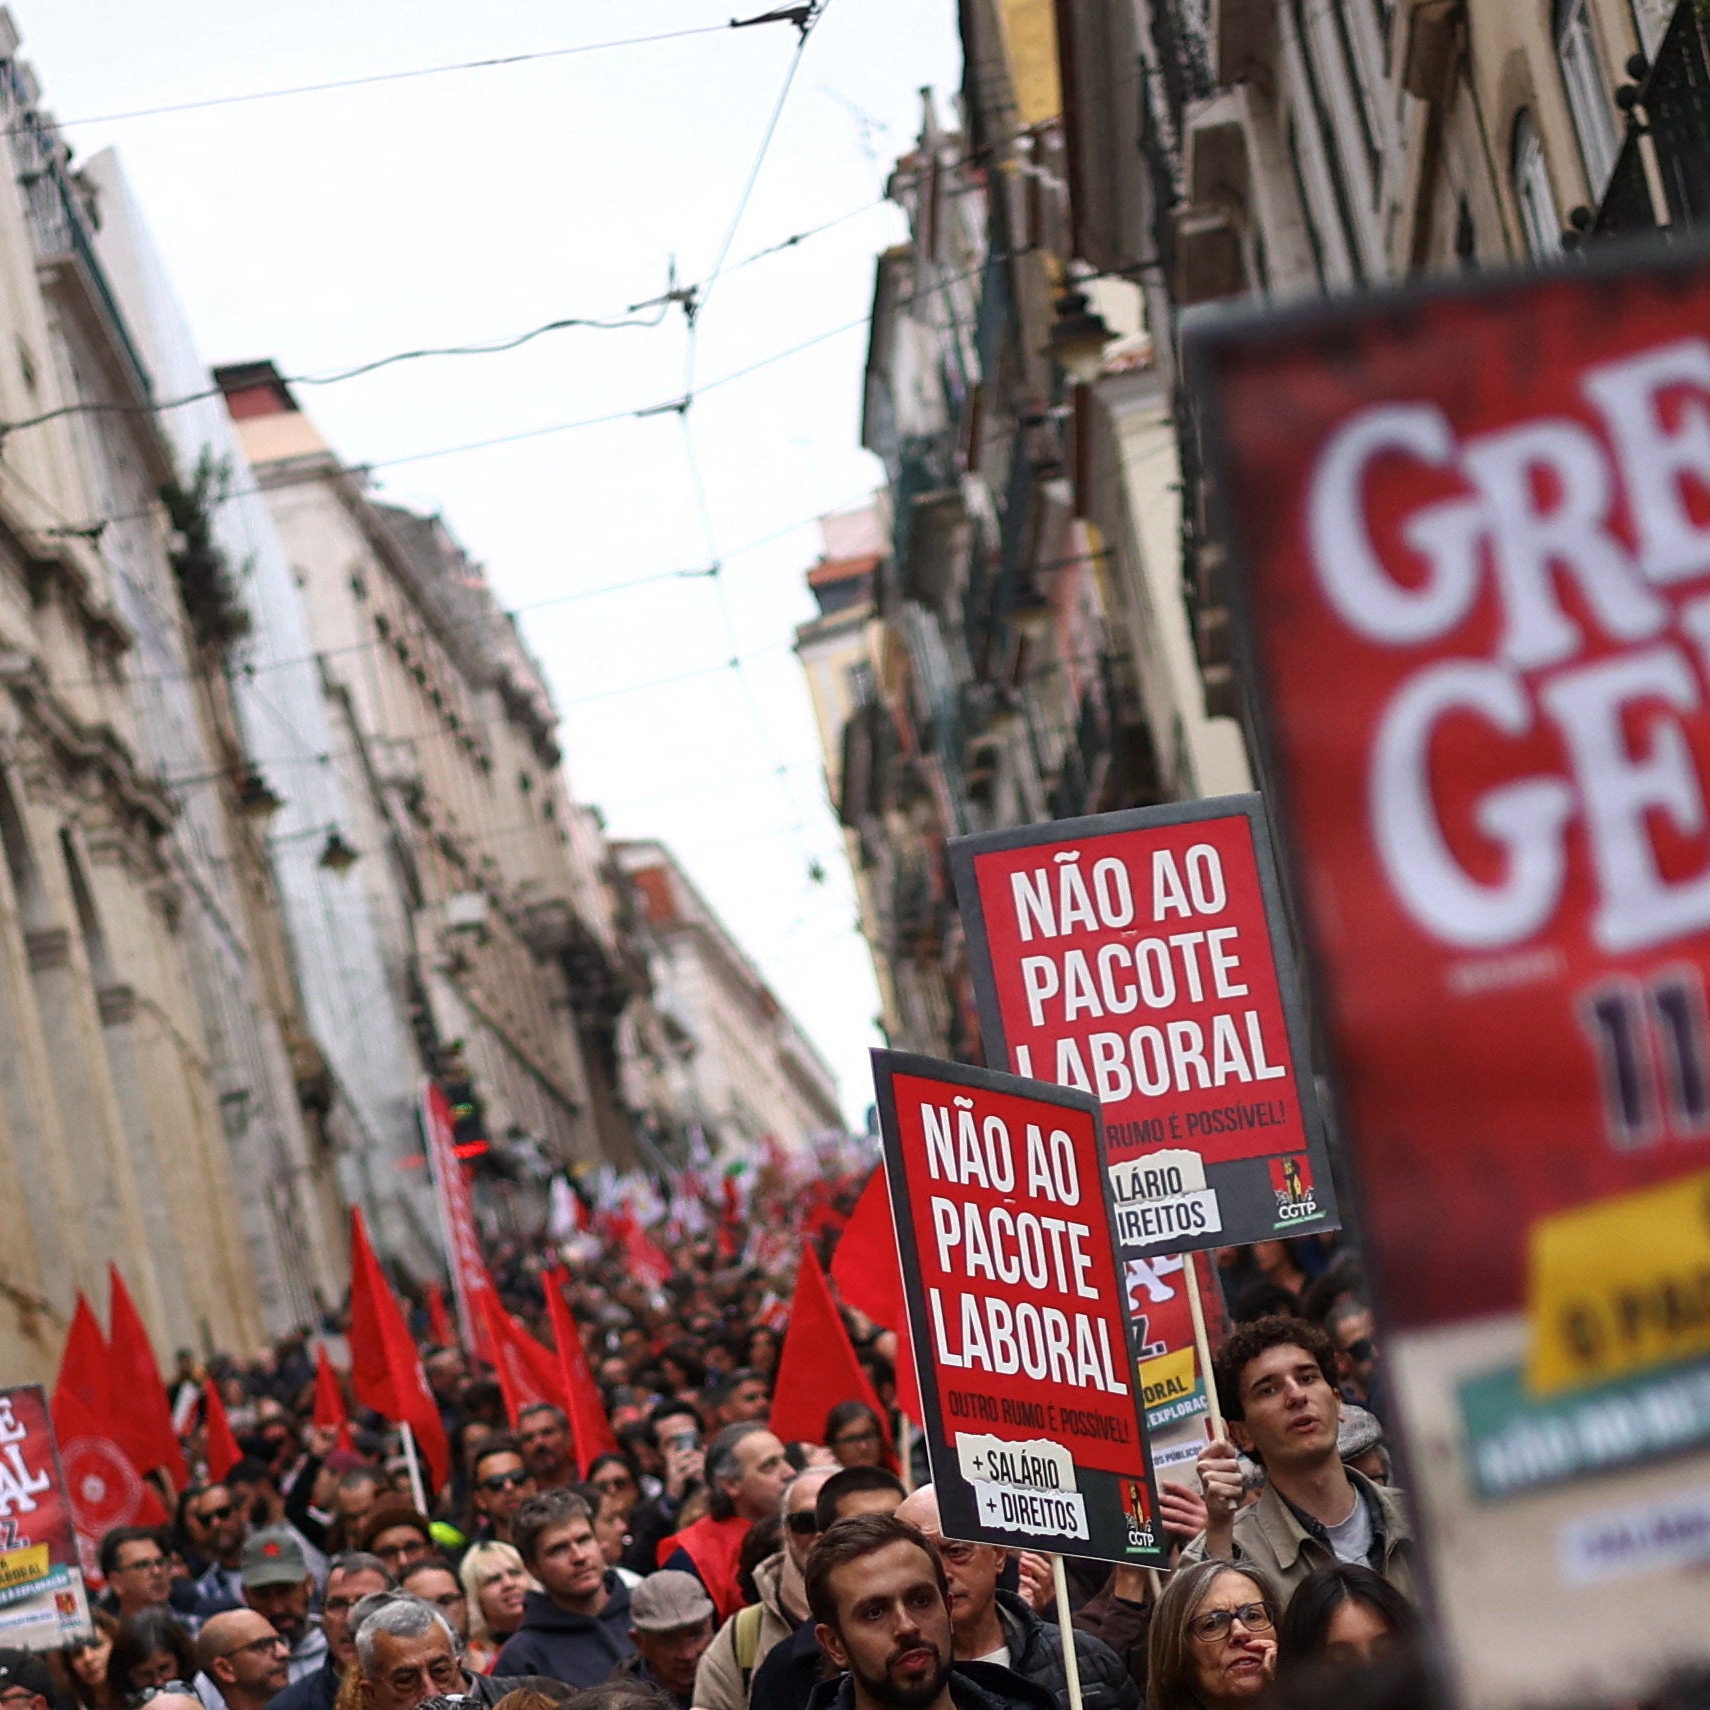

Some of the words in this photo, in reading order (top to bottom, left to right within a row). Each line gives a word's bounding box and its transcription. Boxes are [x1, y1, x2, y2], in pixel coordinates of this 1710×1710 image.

[1010, 850, 1136, 943] NÃO
[1152, 842, 1229, 922] AO
[1021, 925, 1249, 1028] PACOTE
[1106, 1117, 1164, 1149] RUMO
[1170, 1112, 1183, 1140] É
[1187, 1099, 1287, 1137] POSSÍVEL!
[921, 1096, 1012, 1193] NÃO
[1027, 1123, 1080, 1207] AO
[1116, 1166, 1182, 1202] LÁRIO
[1118, 1201, 1207, 1240] IREITOS
[1278, 1201, 1317, 1220] CGTP
[931, 1196, 1099, 1301] PACOTE
[931, 1286, 1127, 1396] LABORAL
[1142, 1375, 1189, 1404] ORAL
[948, 1390, 999, 1423] OUTRO
[1002, 1398, 1046, 1430] RUMO
[1049, 1402, 1059, 1432] É
[1060, 1406, 1131, 1444] POSSÍVEL!
[1149, 1394, 1208, 1426] EXPLORAÇ
[987, 1450, 1060, 1490] SALÁRIO
[1001, 1492, 1078, 1532] DIREITOS
[1128, 1528, 1155, 1547] CGTP
